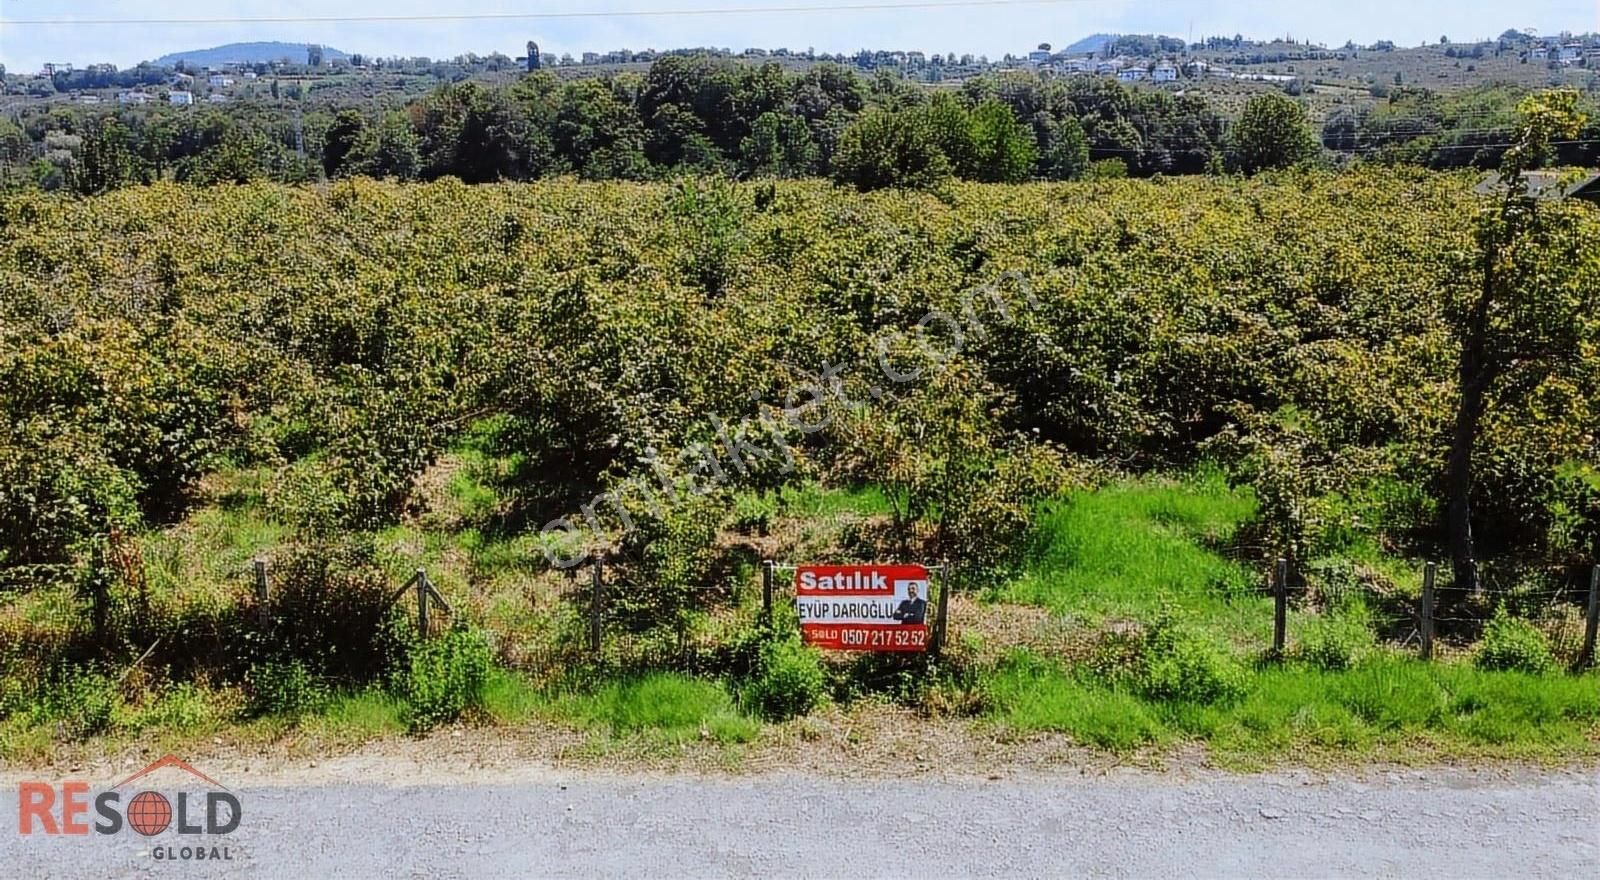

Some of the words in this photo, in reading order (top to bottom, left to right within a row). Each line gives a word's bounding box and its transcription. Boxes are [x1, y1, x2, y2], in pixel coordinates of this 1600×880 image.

[800, 571, 888, 590] Satılık
[799, 599, 829, 619] EYÜP
[833, 600, 894, 619] DARIOĞLU
[841, 629, 869, 645] 0507
[871, 630, 892, 646] 217
[896, 630, 909, 646] 52
[911, 630, 925, 646] 52
